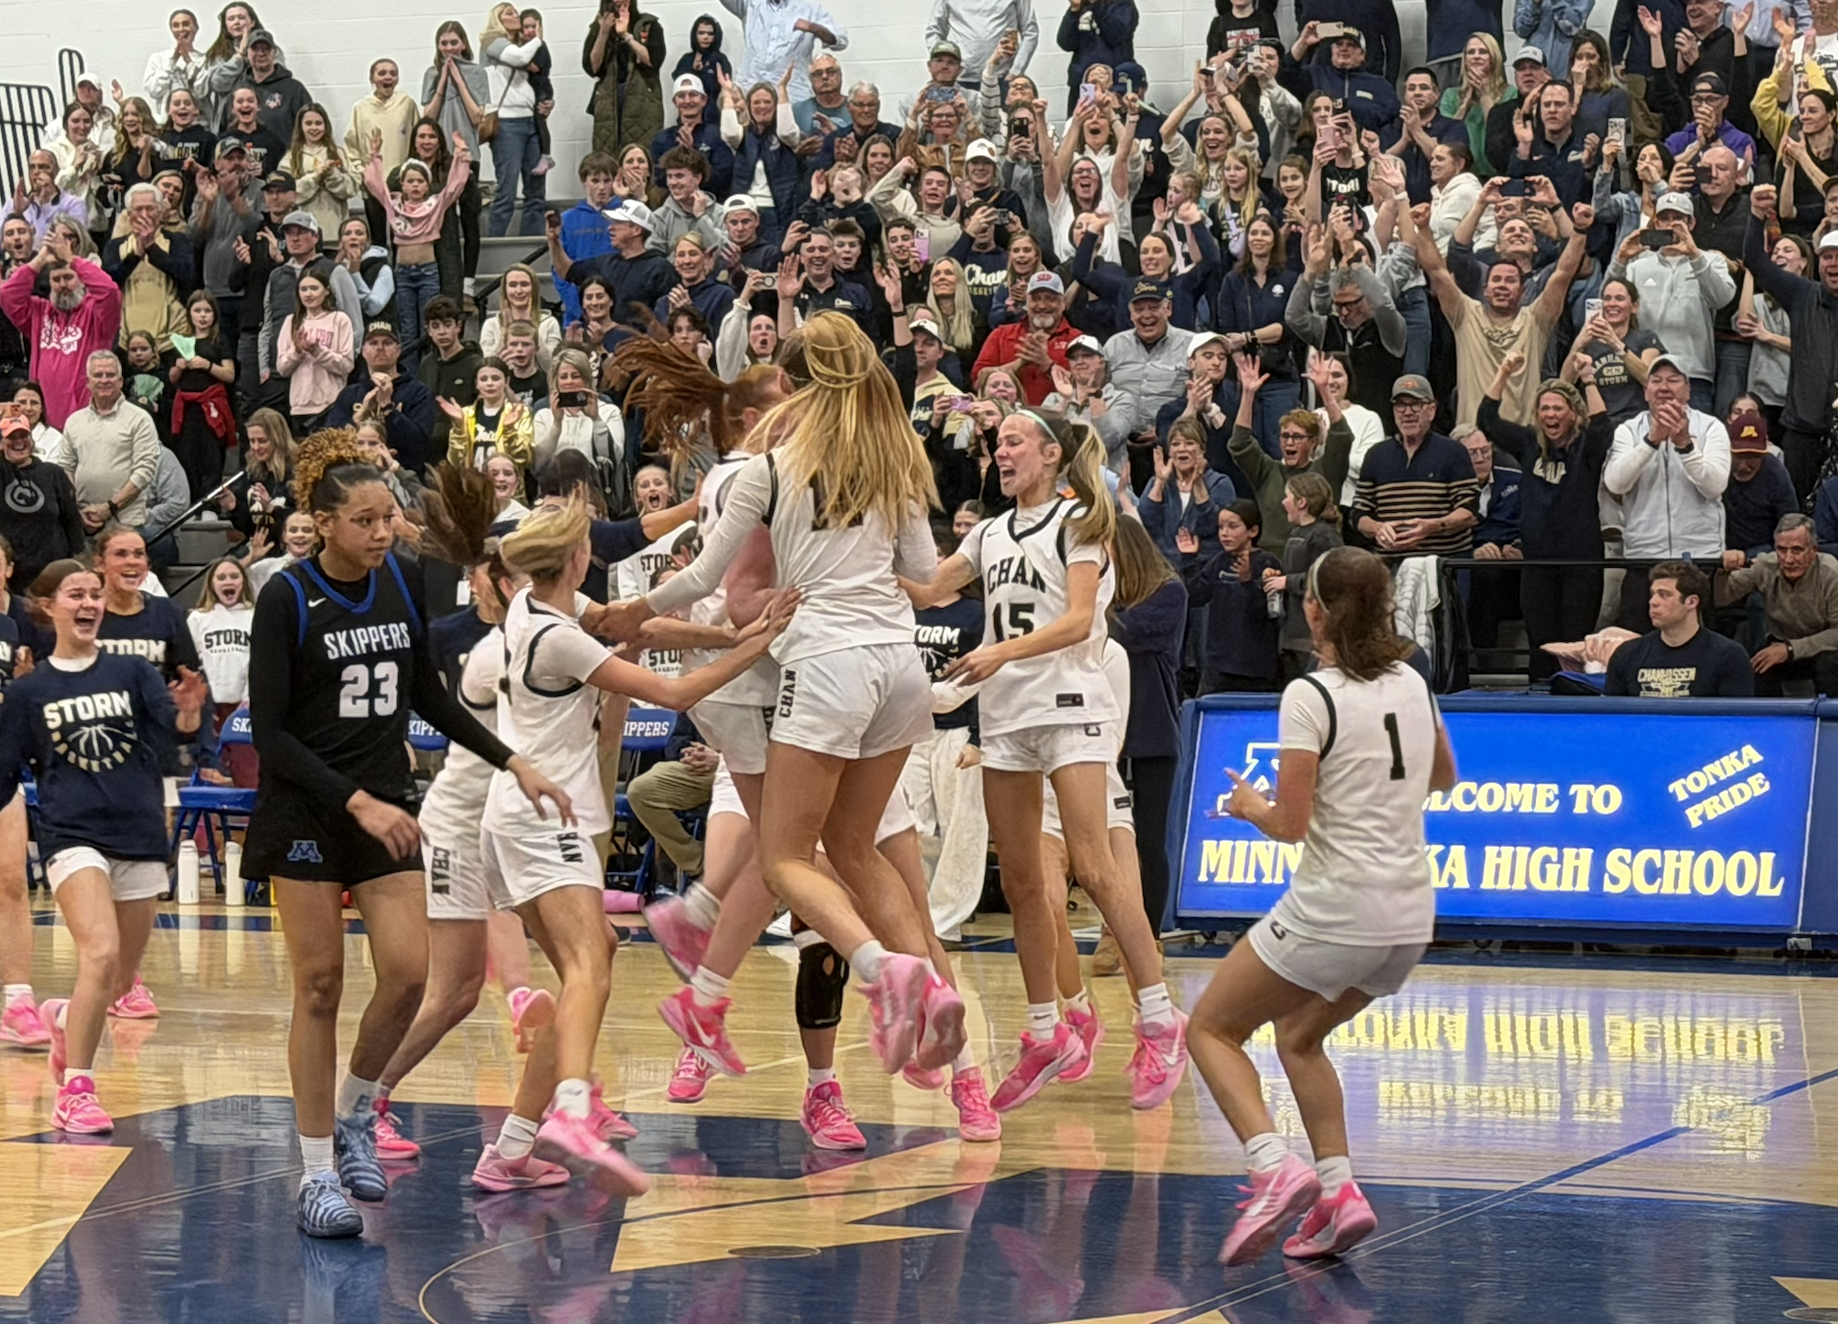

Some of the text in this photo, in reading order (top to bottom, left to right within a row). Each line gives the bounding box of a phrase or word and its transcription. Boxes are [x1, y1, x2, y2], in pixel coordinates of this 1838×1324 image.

[640, 553, 673, 573] STOR
[987, 555, 1046, 595] CHAN
[324, 622, 411, 660] SKIPPERS
[913, 625, 961, 646] TORM
[993, 602, 1035, 643] 15
[648, 649, 682, 667] STO
[339, 661, 399, 718] 23
[779, 669, 797, 719] CHAN
[43, 690, 134, 730] STORM
[623, 721, 670, 737] IPPERS
[1384, 712, 1406, 781] 1
[1668, 744, 1764, 802] TONKA
[1422, 781, 1623, 815] LCOME TO
[1685, 772, 1771, 828] PRIDE
[556, 831, 584, 864] HAN
[1198, 840, 1785, 897] MINNKA HIGH SCHOOL
